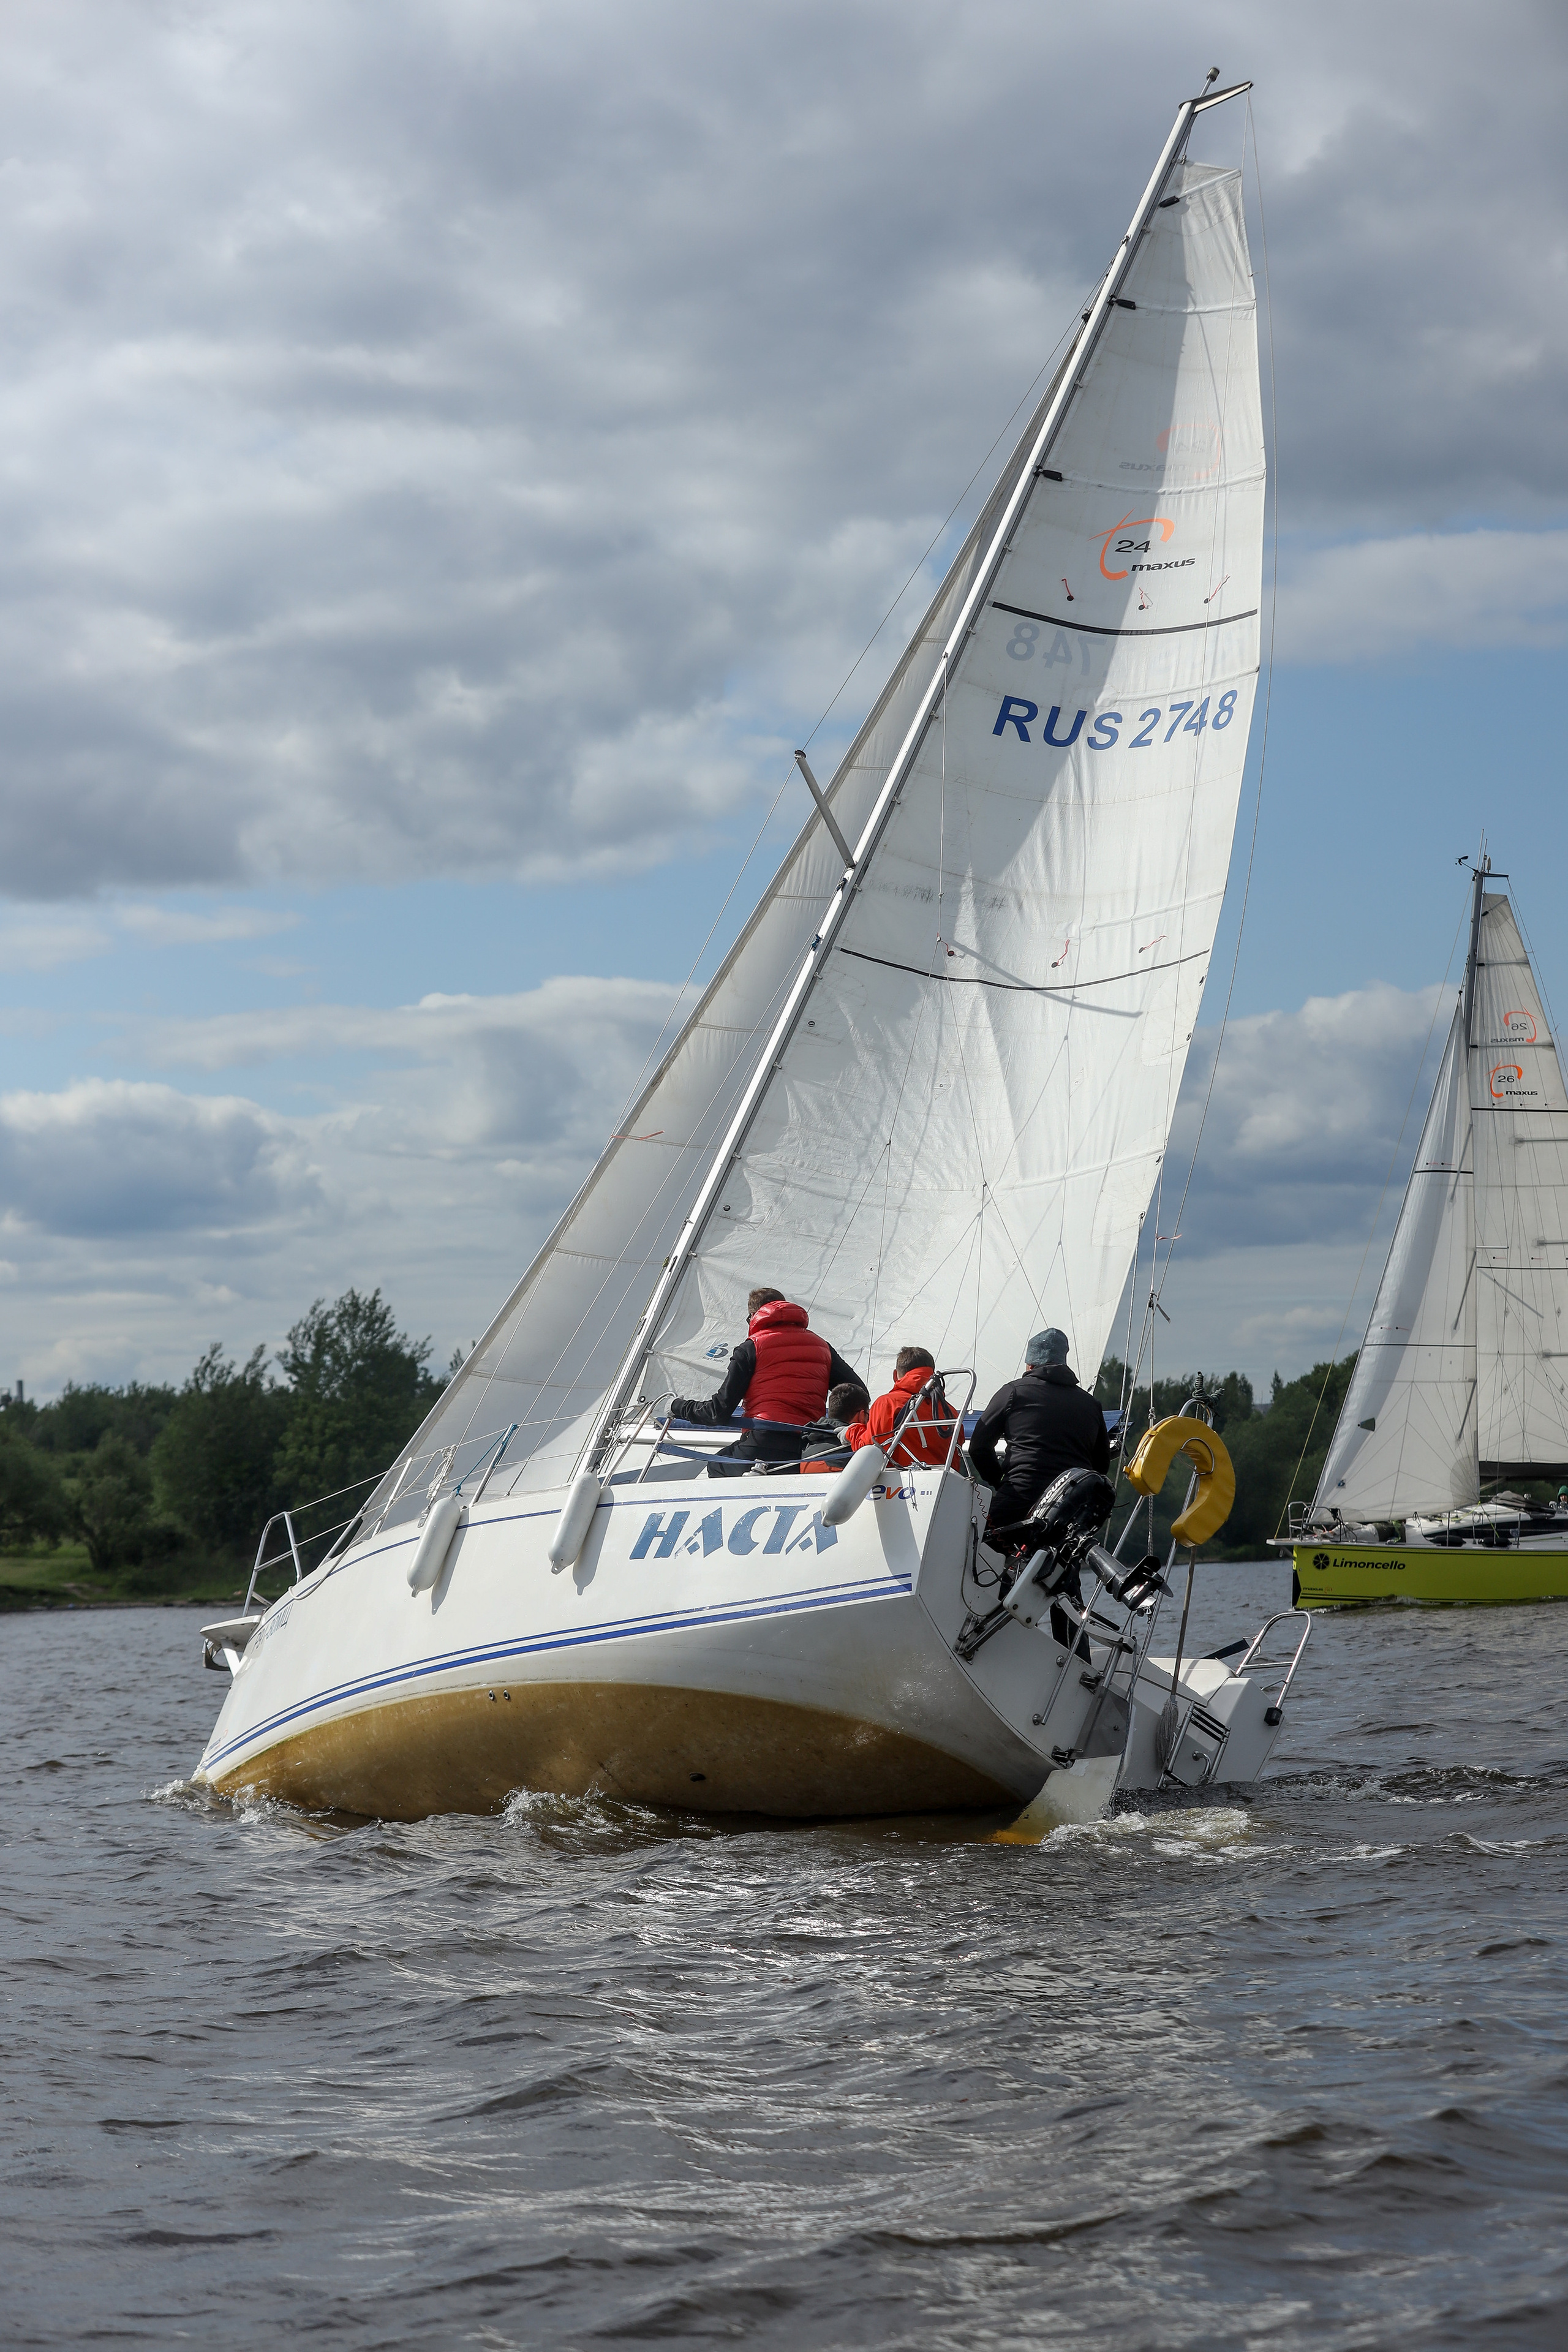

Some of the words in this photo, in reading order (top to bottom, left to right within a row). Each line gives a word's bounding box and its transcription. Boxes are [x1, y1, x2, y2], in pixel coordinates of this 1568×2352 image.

[1115, 540, 1152, 554] 24
[1131, 557, 1196, 572] maxus
[992, 695, 1123, 750] RUS
[1129, 690, 1238, 749] 2748
[865, 1485, 916, 1500] evo
[1333, 1558, 1406, 1570] Limoncello
